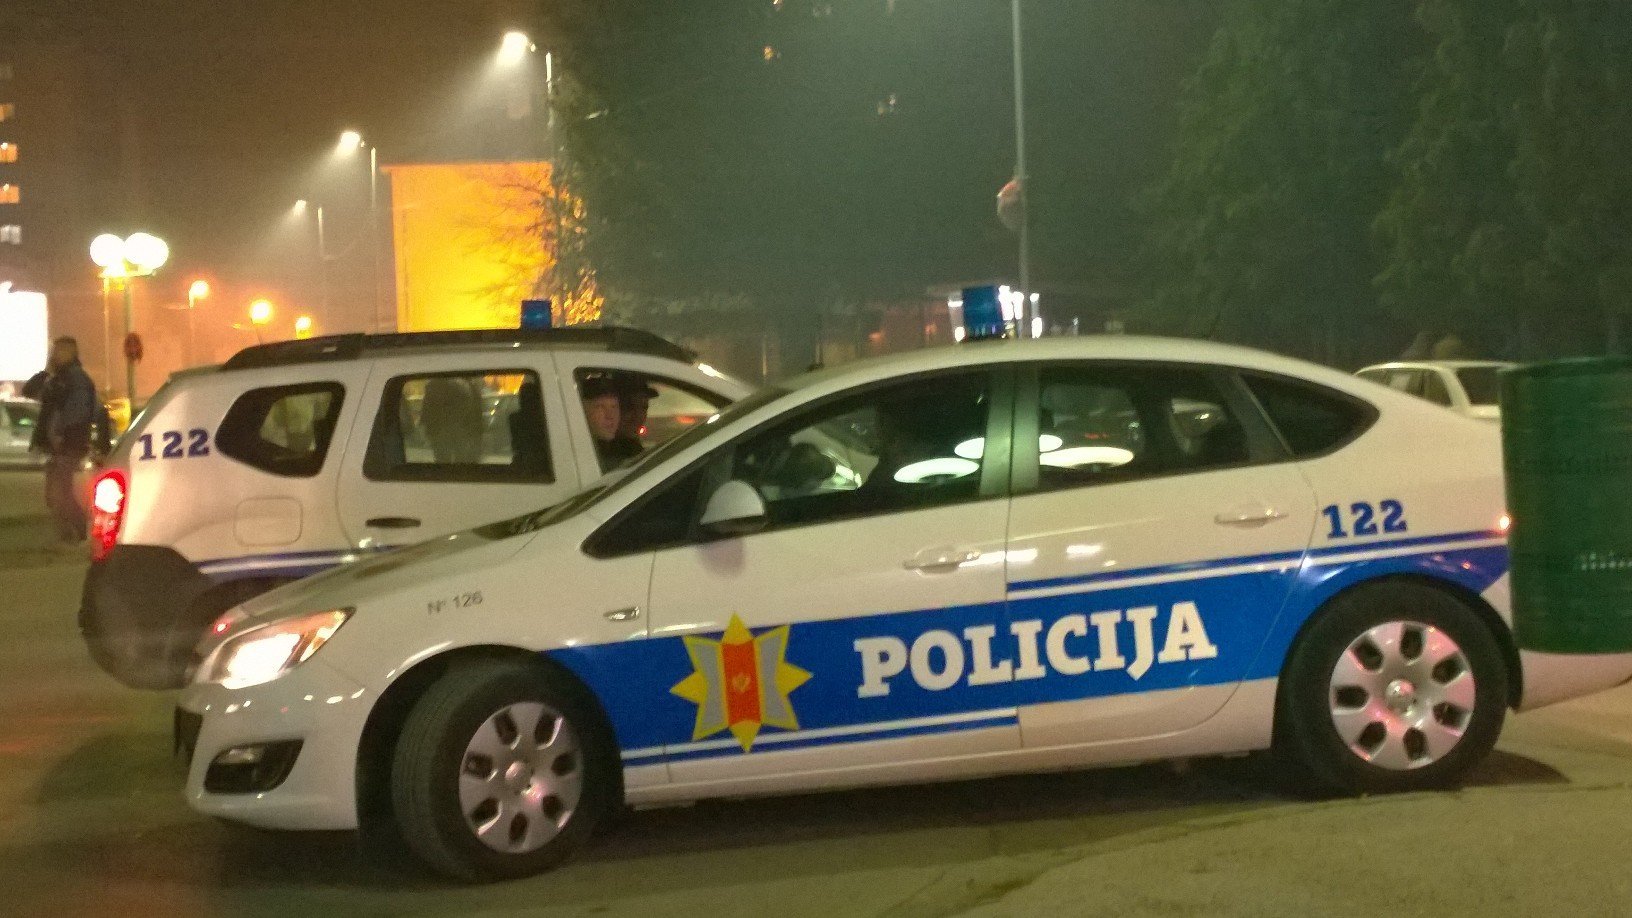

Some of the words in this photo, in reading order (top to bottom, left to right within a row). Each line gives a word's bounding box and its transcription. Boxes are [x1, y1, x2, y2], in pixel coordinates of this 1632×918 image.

[138, 428, 210, 461] 122
[1322, 498, 1408, 539] 122
[453, 591, 483, 608] 126
[853, 600, 1218, 699] POLICIJA
